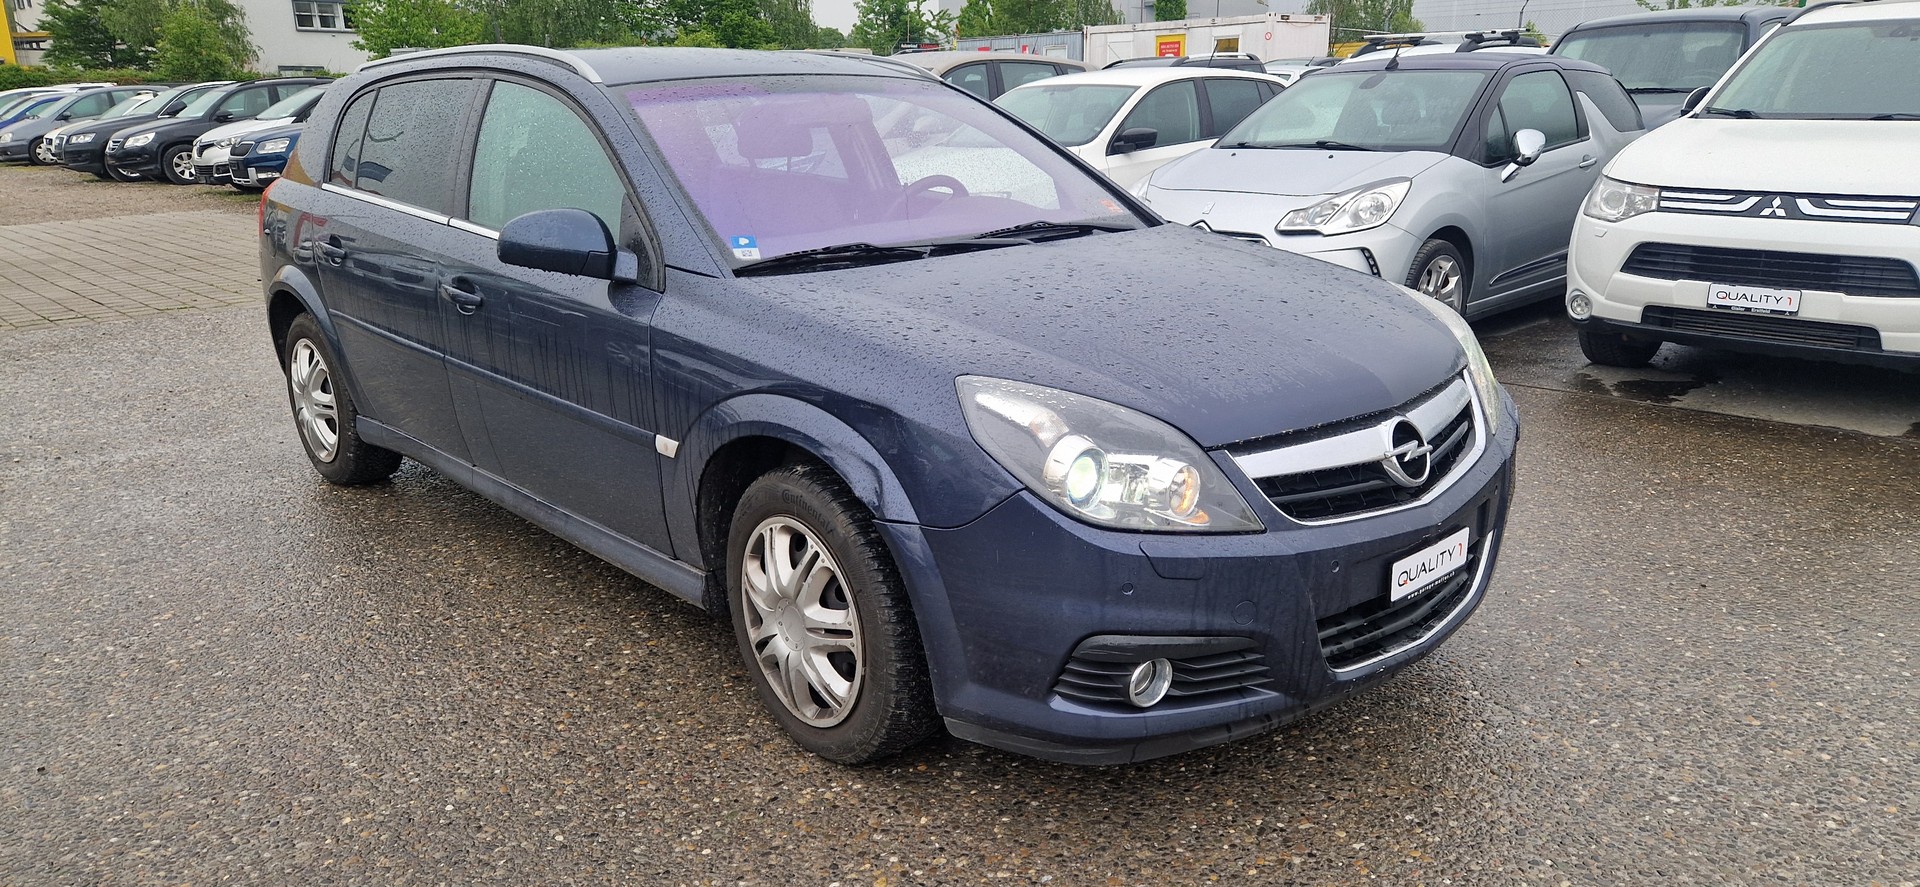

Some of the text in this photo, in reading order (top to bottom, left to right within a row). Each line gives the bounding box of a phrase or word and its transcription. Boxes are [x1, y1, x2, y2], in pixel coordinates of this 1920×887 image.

[1715, 290, 1793, 306] QUALITY 1
[1397, 542, 1463, 588] QUALITY 1
